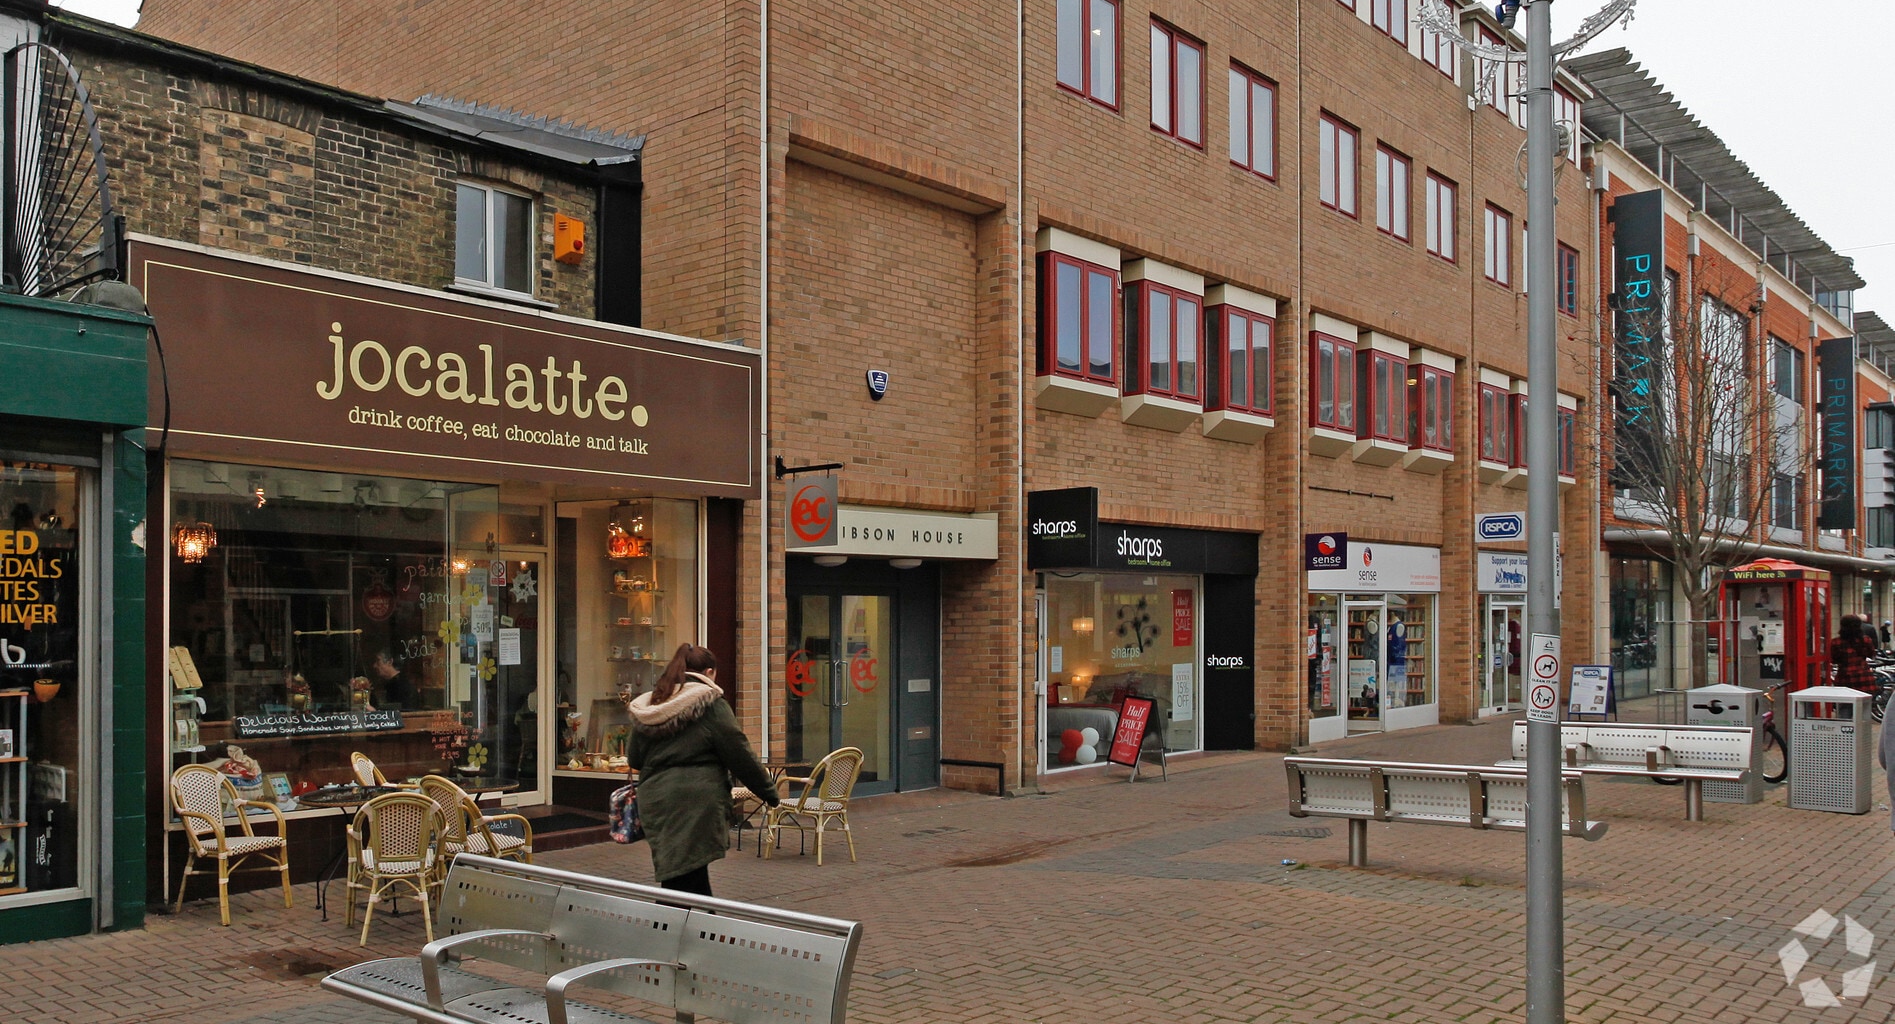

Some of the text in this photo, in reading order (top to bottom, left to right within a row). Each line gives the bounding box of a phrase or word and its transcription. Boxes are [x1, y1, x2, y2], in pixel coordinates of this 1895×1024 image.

[1626, 254, 1652, 426] PRIMARK
[316, 321, 649, 427] jocalatte.
[348, 405, 649, 455] drink coffee, eat chocolate and talk
[1828, 378, 1847, 490] PRIMARK
[1032, 518, 1077, 538] sharps
[1485, 521, 1517, 533] RSPCA
[912, 530, 963, 545] HOUSE
[1117, 529, 1163, 563] sharps
[1312, 556, 1341, 565] sense
[1491, 556, 1508, 566] Support
[1509, 558, 1518, 566] your
[1359, 570, 1377, 581] sense
[1734, 571, 1775, 579] WiFi here
[1111, 646, 1140, 662] sharps
[1207, 654, 1244, 668] sharps
[1177, 695, 1189, 707] OFF
[237, 714, 300, 727] Delicious
[303, 712, 358, 725] Warming
[1127, 705, 1146, 720] Half
[241, 726, 277, 735] Homemade
[1121, 718, 1144, 730] PRICE
[1811, 724, 1835, 732] Litter
[1117, 729, 1141, 747] SALE
